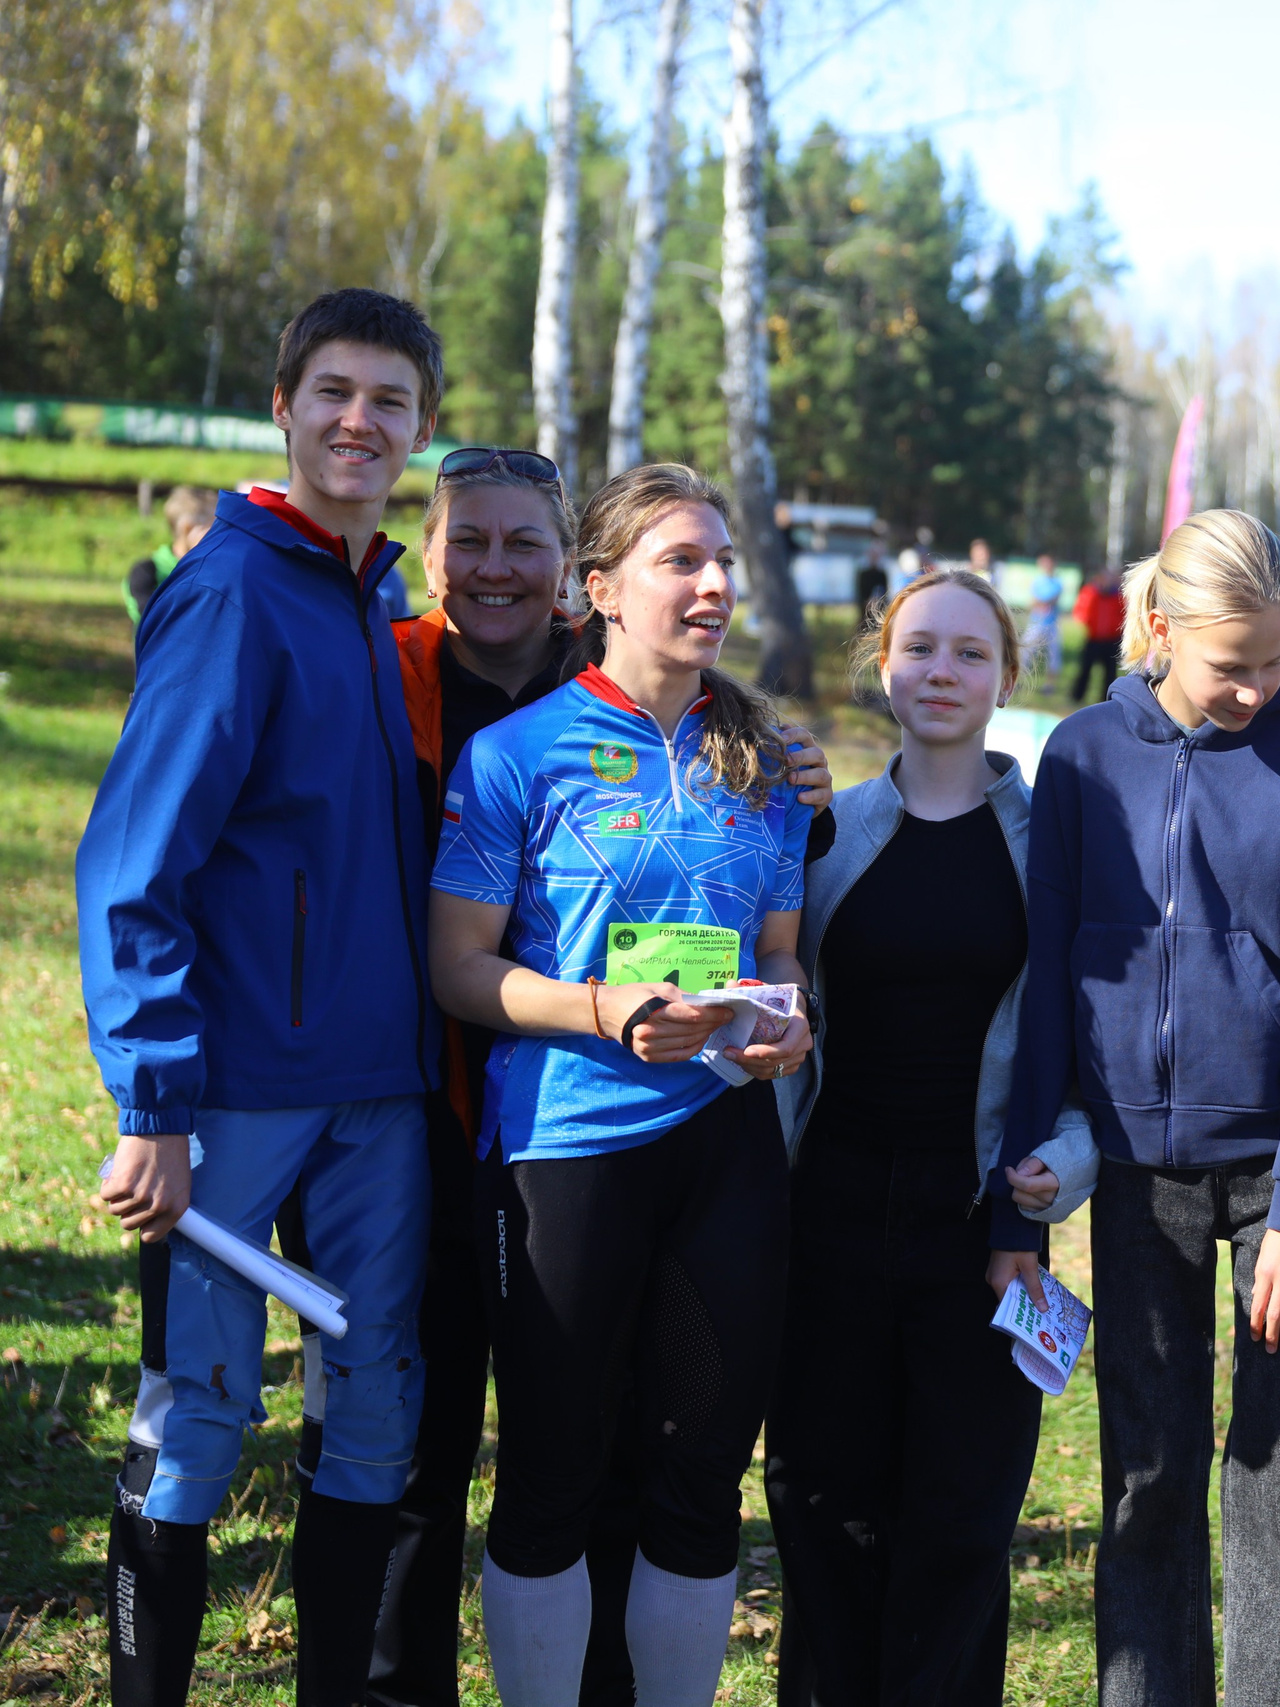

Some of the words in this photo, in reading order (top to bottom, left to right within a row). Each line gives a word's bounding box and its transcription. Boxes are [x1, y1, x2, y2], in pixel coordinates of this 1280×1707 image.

[607, 814, 637, 828] SFR
[659, 929, 698, 938] ГОРЯЧАЯ
[699, 929, 736, 939] ДЕСЯТКА
[706, 970, 735, 980] ЭТАП
[497, 1209, 508, 1299] noname
[1025, 1300, 1036, 1336] ДЕСЯТК
